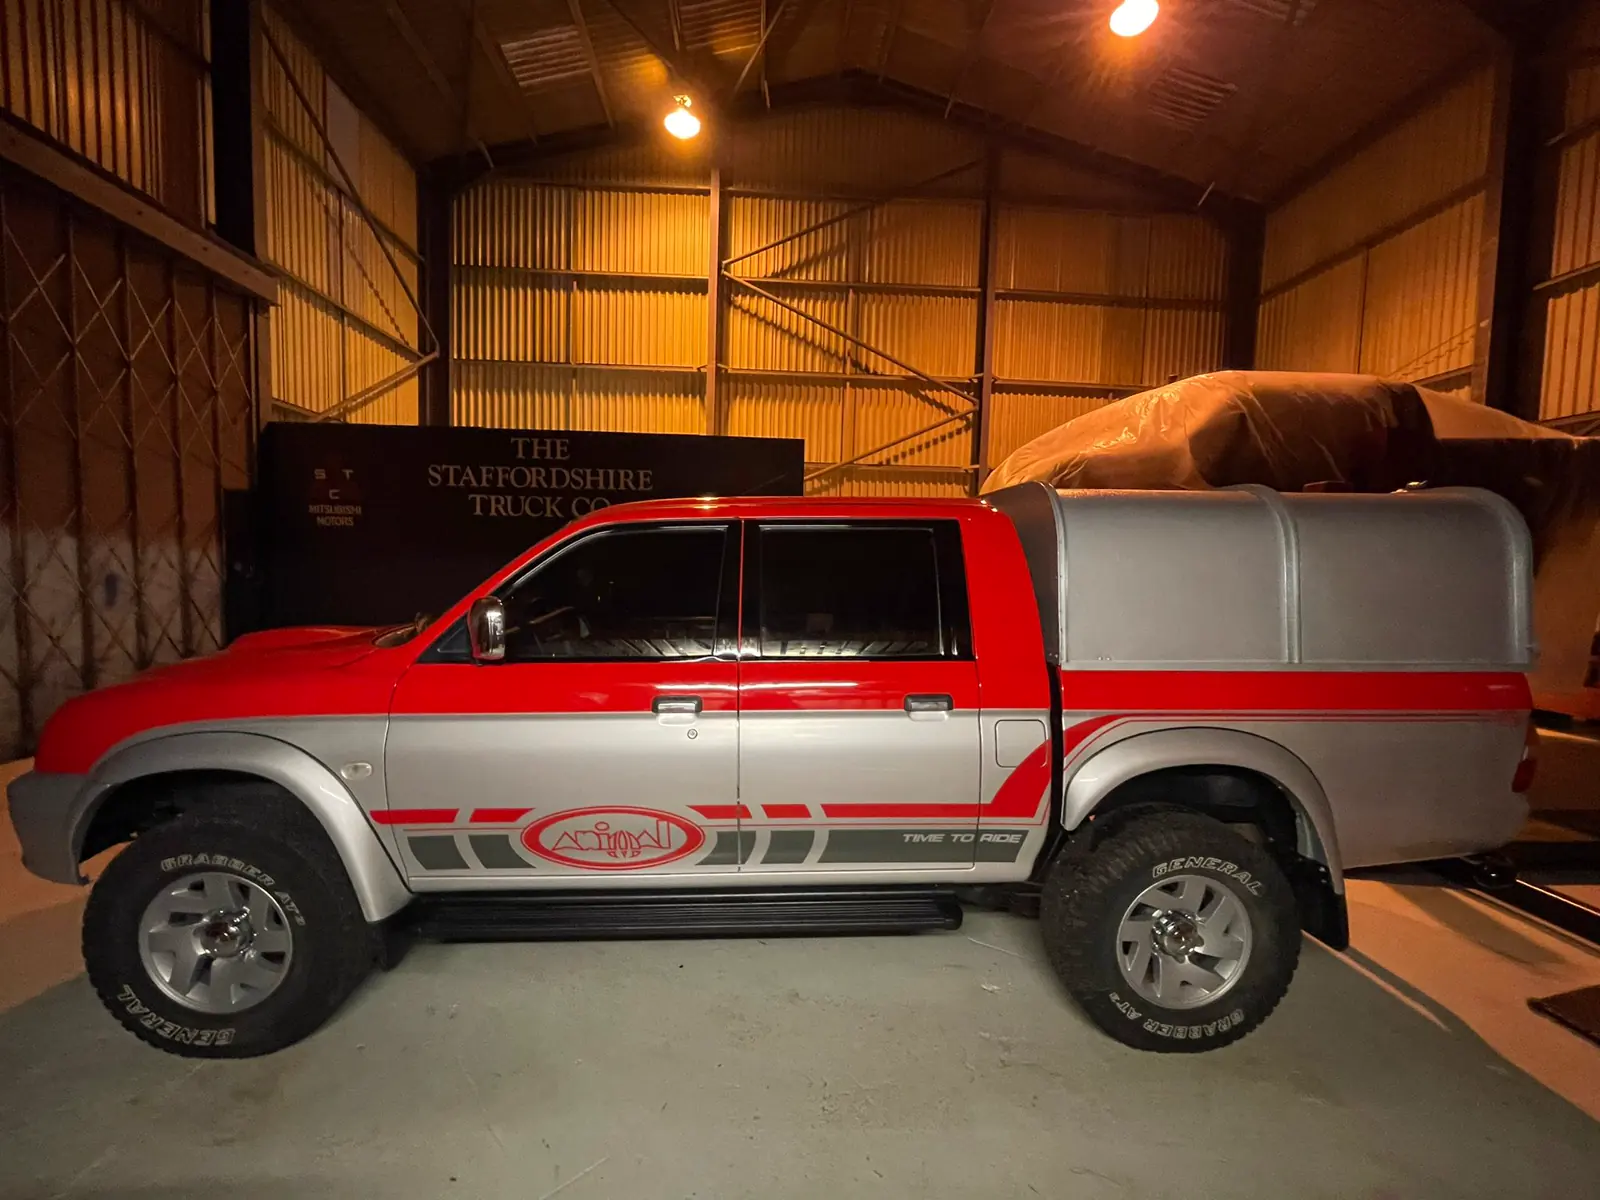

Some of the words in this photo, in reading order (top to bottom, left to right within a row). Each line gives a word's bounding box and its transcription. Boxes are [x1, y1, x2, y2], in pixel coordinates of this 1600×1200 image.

[511, 437, 570, 460] THE
[314, 468, 326, 480] S
[341, 468, 354, 481] T
[428, 464, 653, 490] STAFFORDSHIRE
[329, 488, 341, 500] C
[468, 494, 564, 518] TRUCK
[316, 516, 354, 527] MOTORS
[902, 833, 945, 844] TIME
[950, 833, 975, 844] TO
[979, 833, 1022, 844] RIDE
[161, 853, 275, 886] GRABBER
[1152, 856, 1263, 896] GENERAL
[117, 984, 236, 1045] GENERAL
[1143, 1008, 1245, 1039] GRABBER
